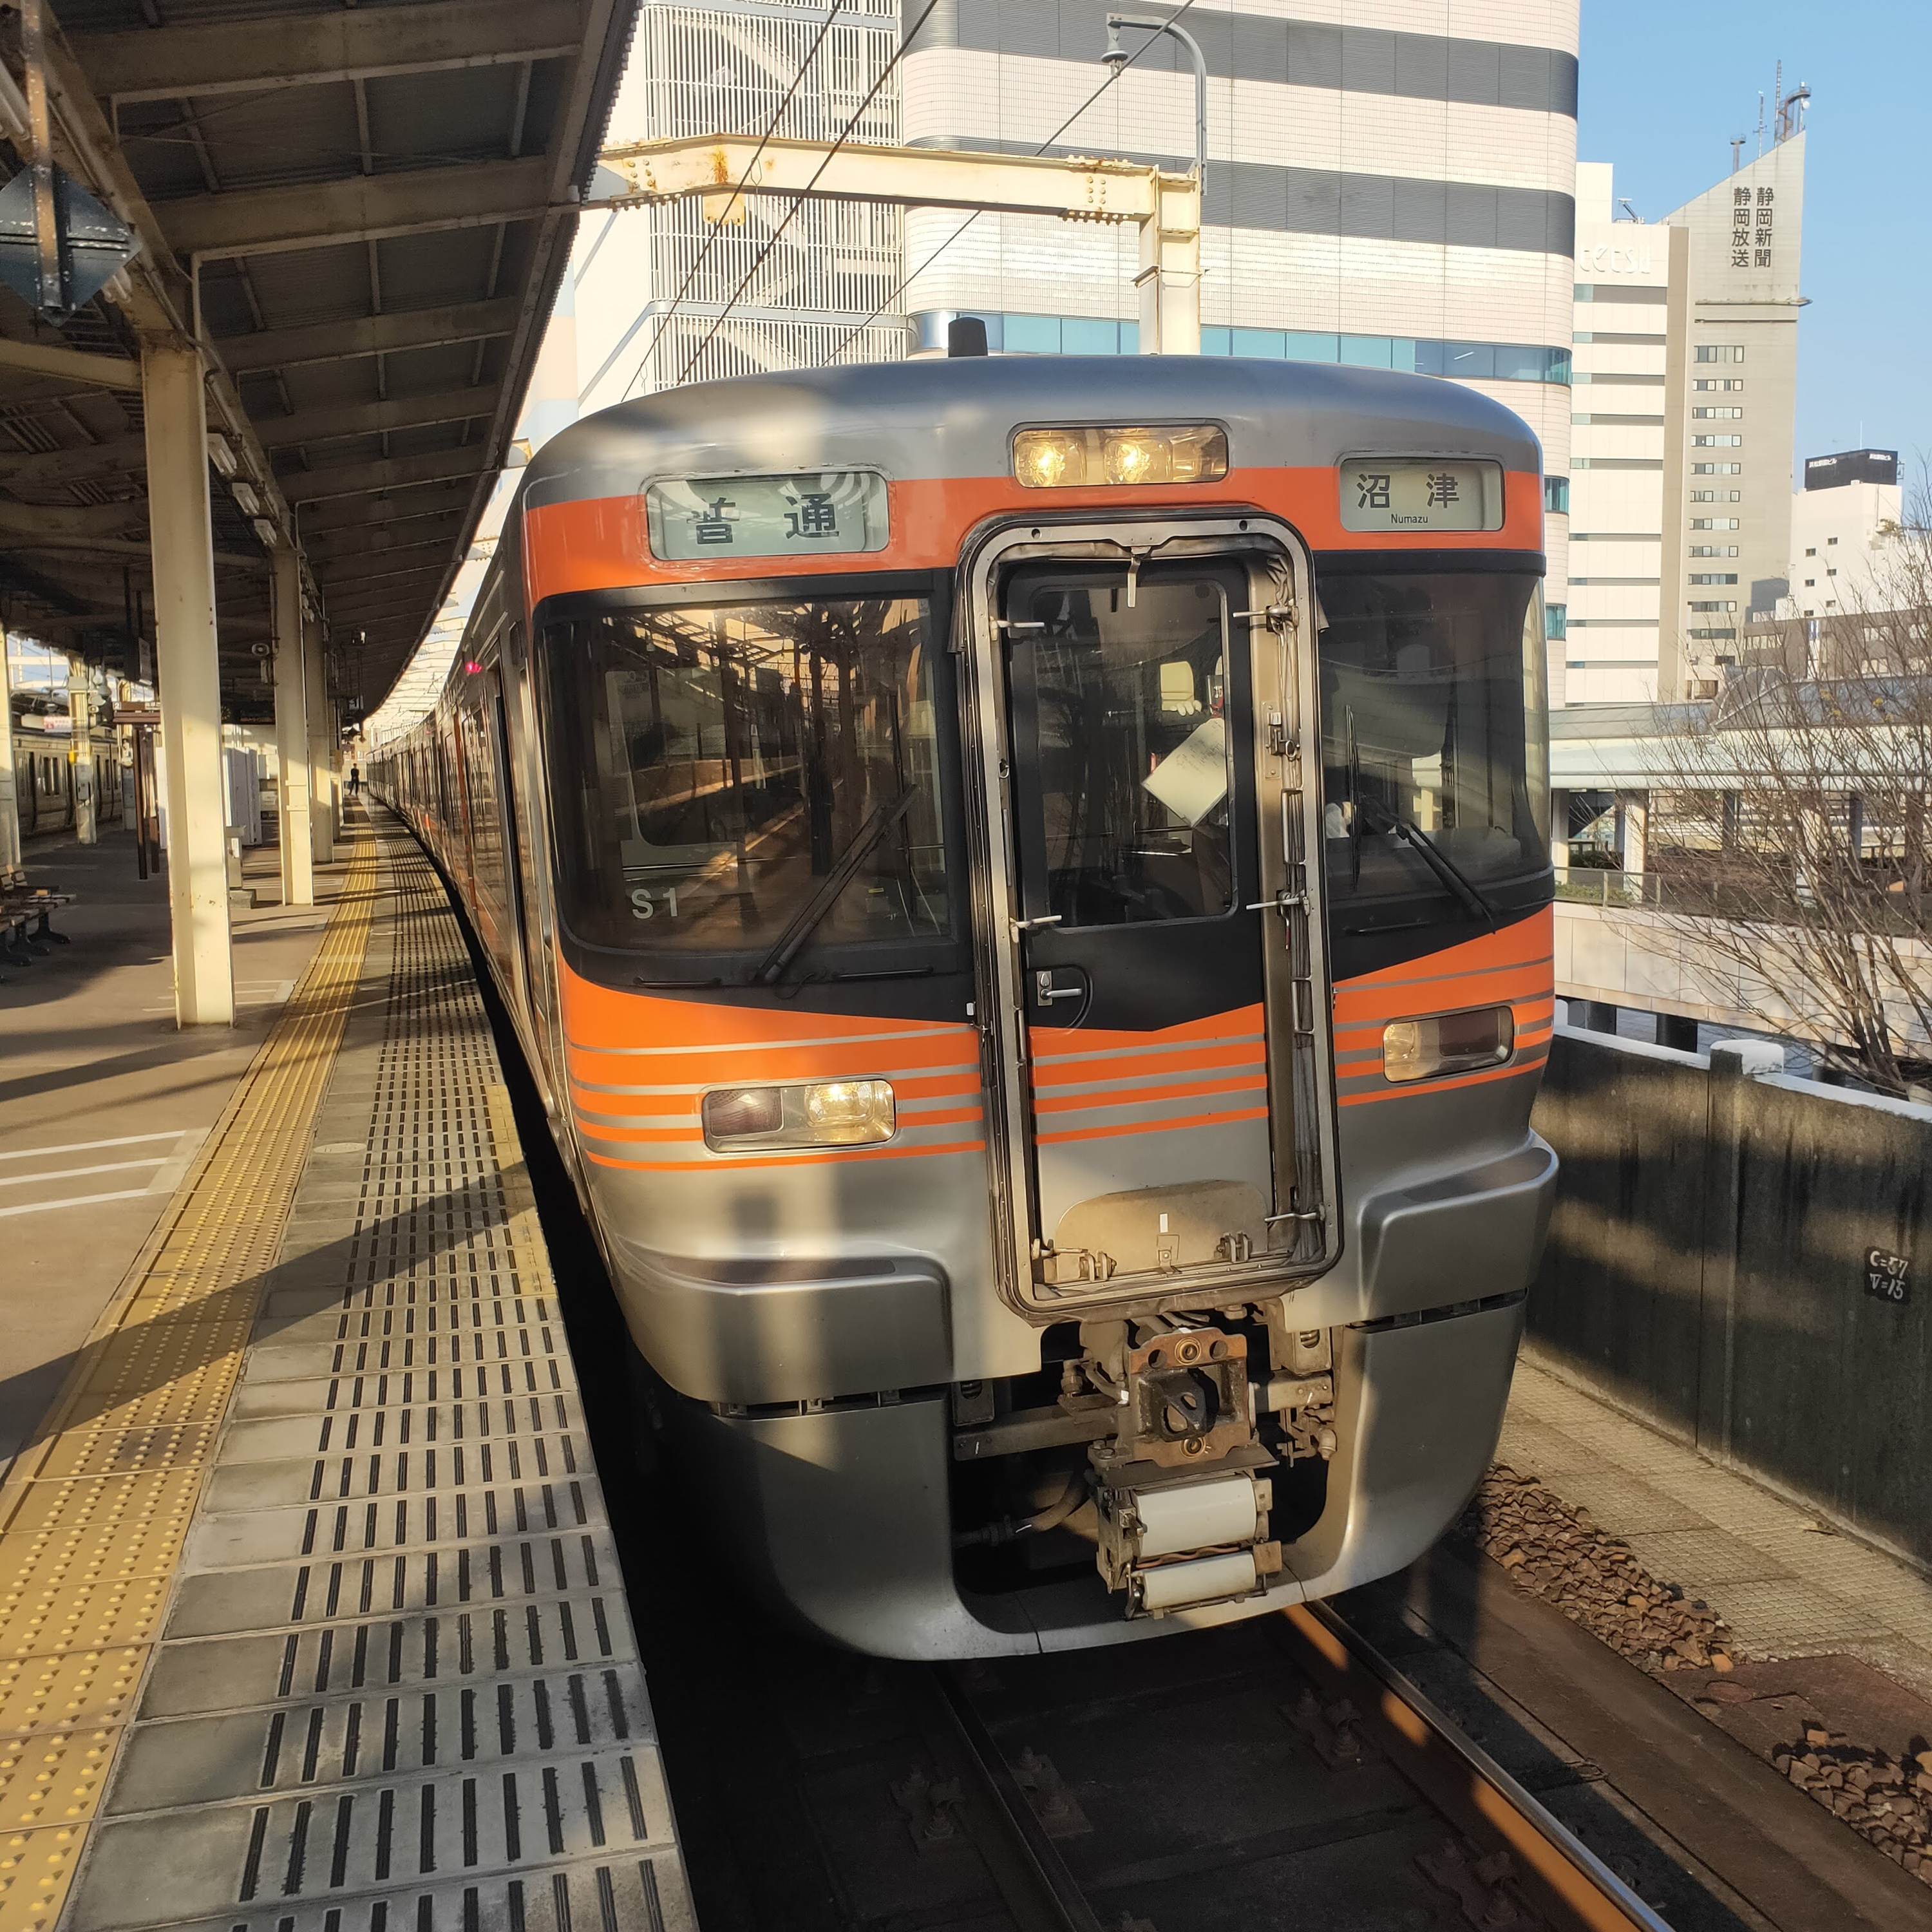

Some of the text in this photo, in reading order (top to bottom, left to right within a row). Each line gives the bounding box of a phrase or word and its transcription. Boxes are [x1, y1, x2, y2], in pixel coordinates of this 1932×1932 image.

[1731, 187, 1752, 268] 静岡放送
[1754, 187, 1774, 268] 静岡新聞
[1356, 472, 1460, 509] 沼津
[687, 492, 840, 545] 普通
[1391, 513, 1428, 524] Numazu
[632, 887, 678, 919] S1
